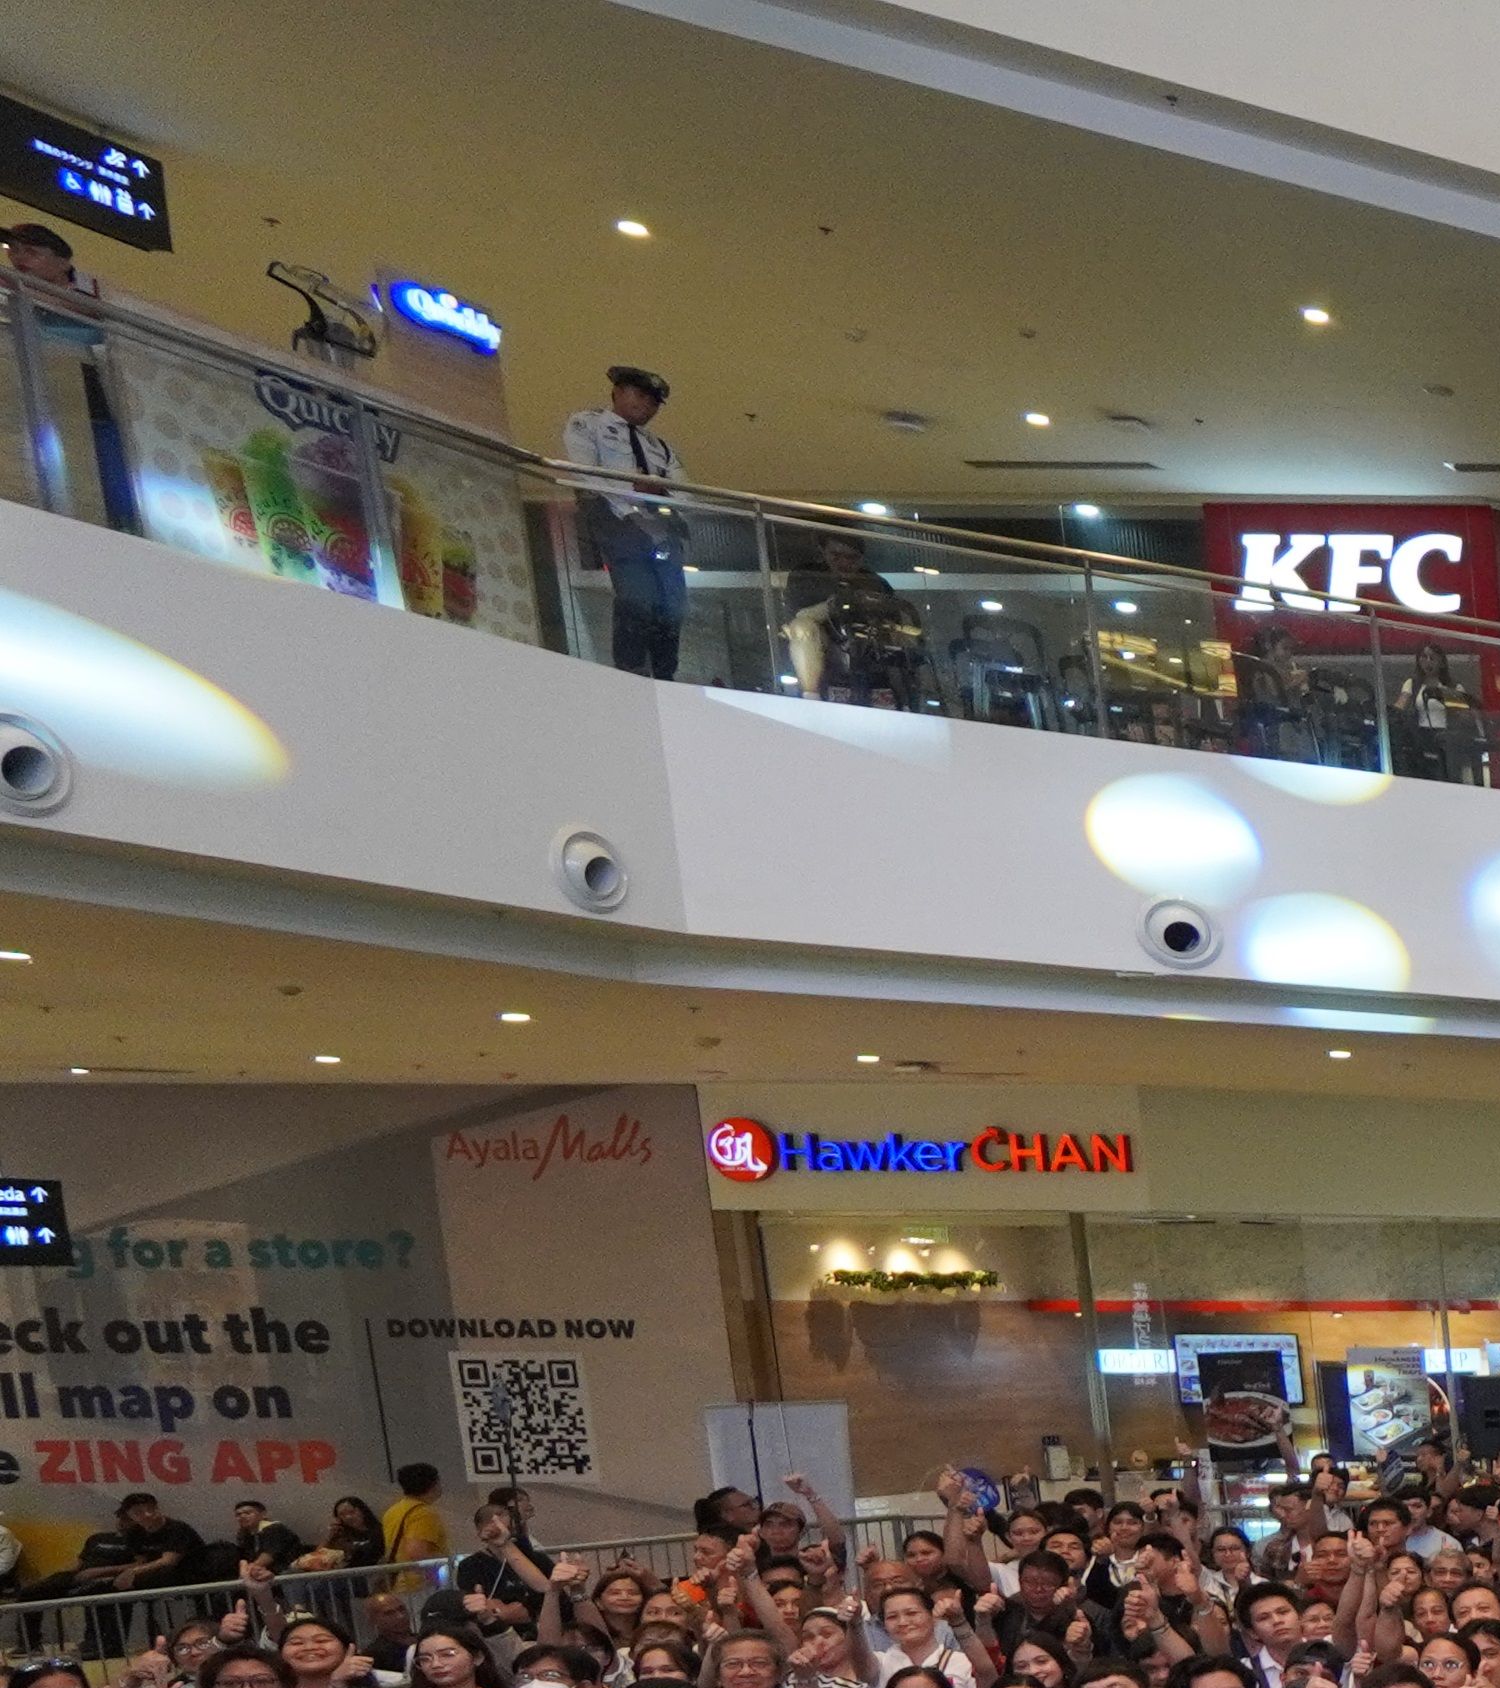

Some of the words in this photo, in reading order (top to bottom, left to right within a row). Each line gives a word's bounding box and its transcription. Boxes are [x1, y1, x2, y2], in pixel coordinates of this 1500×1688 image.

[1234, 533, 1462, 613] KFC
[447, 1130, 539, 1169] Ayala
[532, 1112, 652, 1181] Malls
[106, 1227, 188, 1269] for
[204, 1238, 233, 1269] a
[247, 1229, 416, 1270] store?
[103, 1312, 212, 1355] out
[221, 1306, 330, 1355] the
[387, 1318, 557, 1339] DOWNLOAD
[564, 1318, 635, 1339] NOW
[58, 1382, 196, 1432] map
[212, 1383, 292, 1419] on
[34, 1438, 193, 1485] ZING
[210, 1438, 337, 1485] APP
